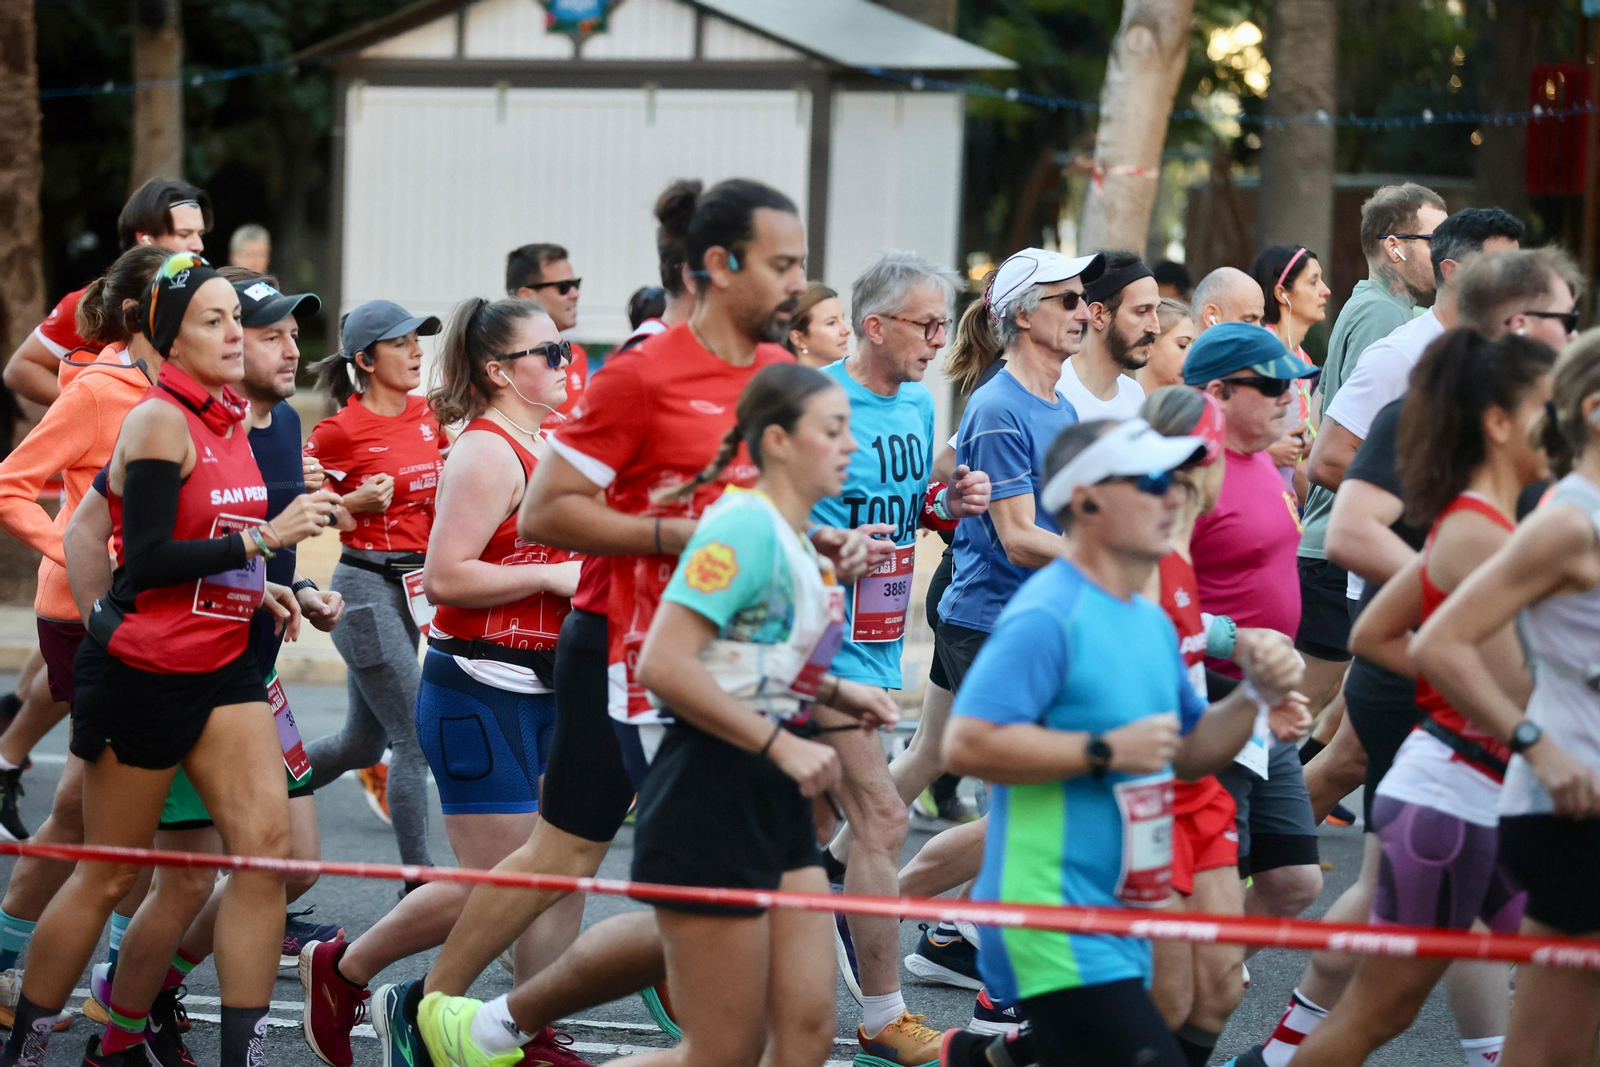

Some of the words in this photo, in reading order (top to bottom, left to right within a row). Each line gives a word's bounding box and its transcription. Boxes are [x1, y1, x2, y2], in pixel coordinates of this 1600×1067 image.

[872, 433, 924, 484] 100
[210, 487, 244, 505] SAN
[884, 581, 906, 597] 3885
